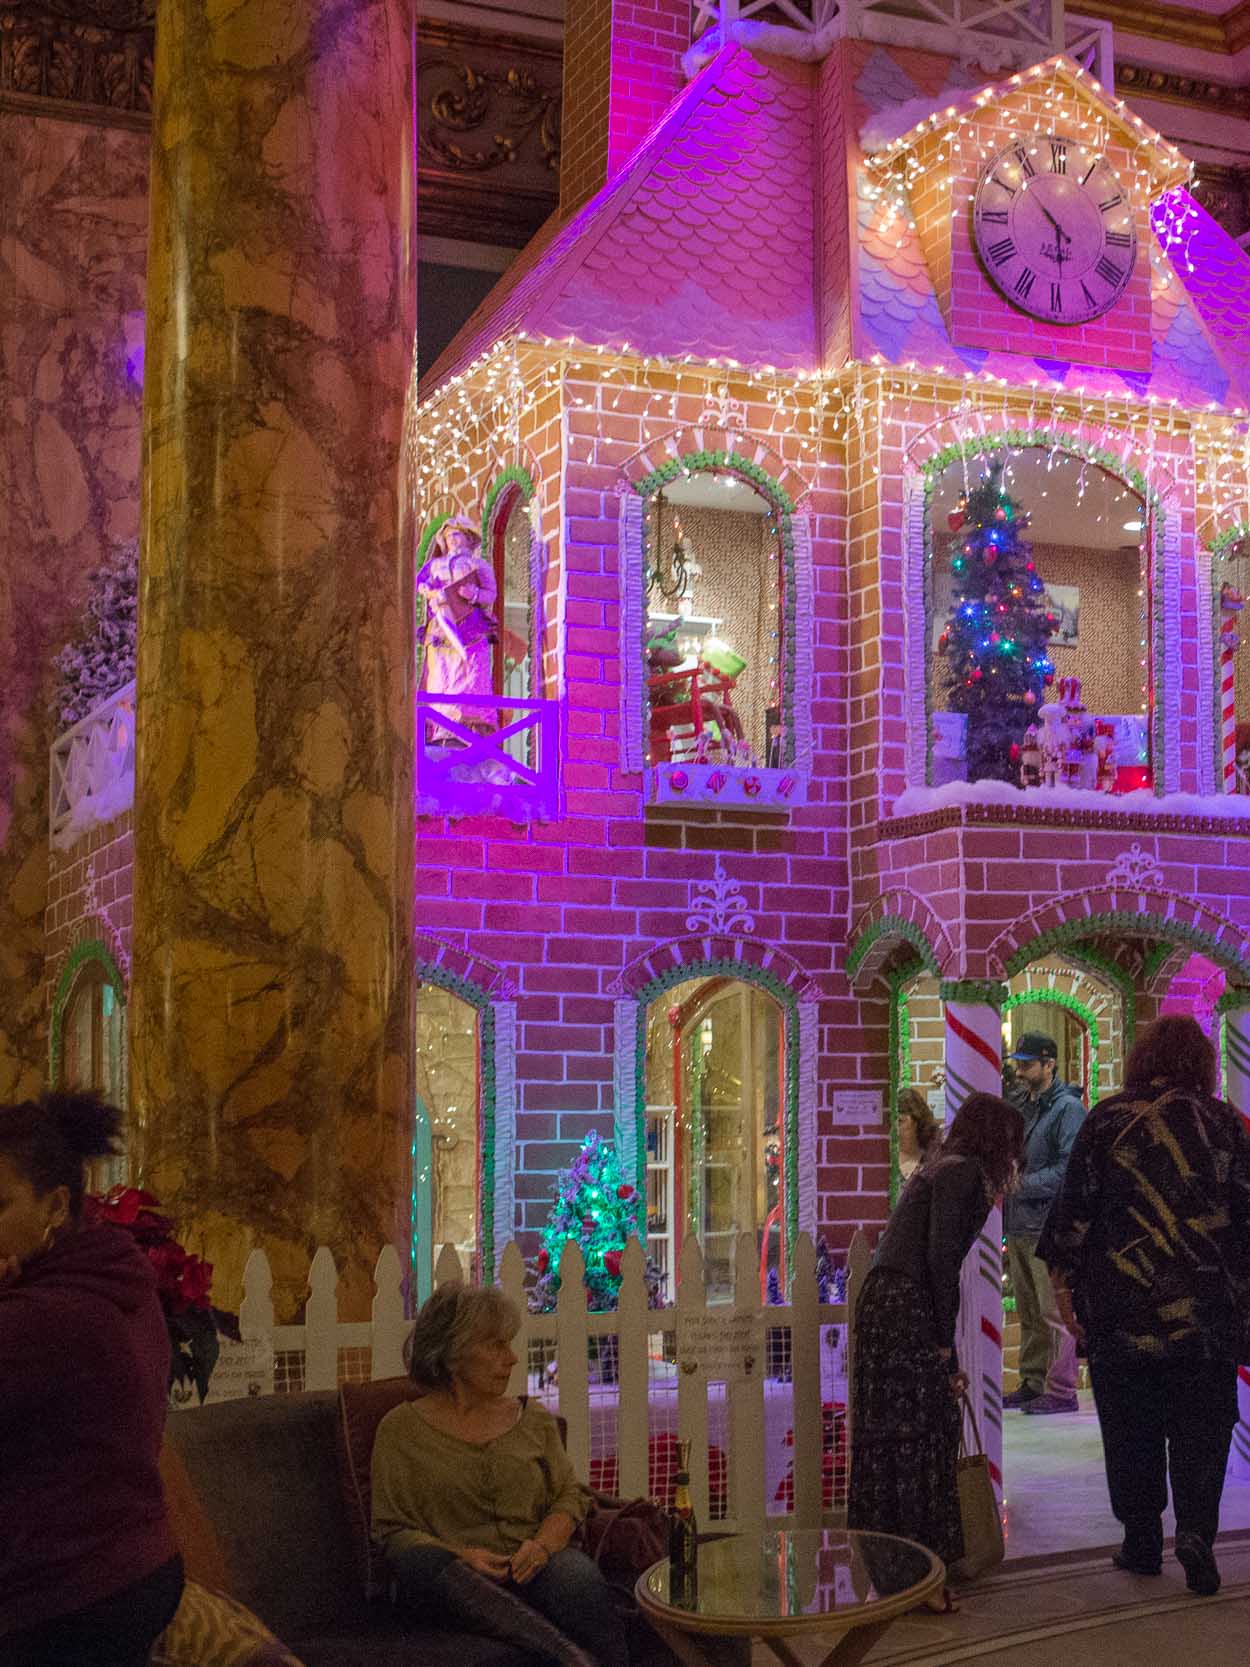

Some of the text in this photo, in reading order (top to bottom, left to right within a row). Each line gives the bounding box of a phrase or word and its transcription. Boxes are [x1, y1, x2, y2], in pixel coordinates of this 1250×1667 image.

[1051, 143, 1066, 174] XII
[982, 210, 1008, 225] IX
[1099, 195, 1122, 213] II
[988, 238, 1016, 266] VIII
[1106, 231, 1131, 247] III
[1014, 268, 1036, 299] VII
[1050, 283, 1062, 312] VI
[1081, 280, 1097, 308] V
